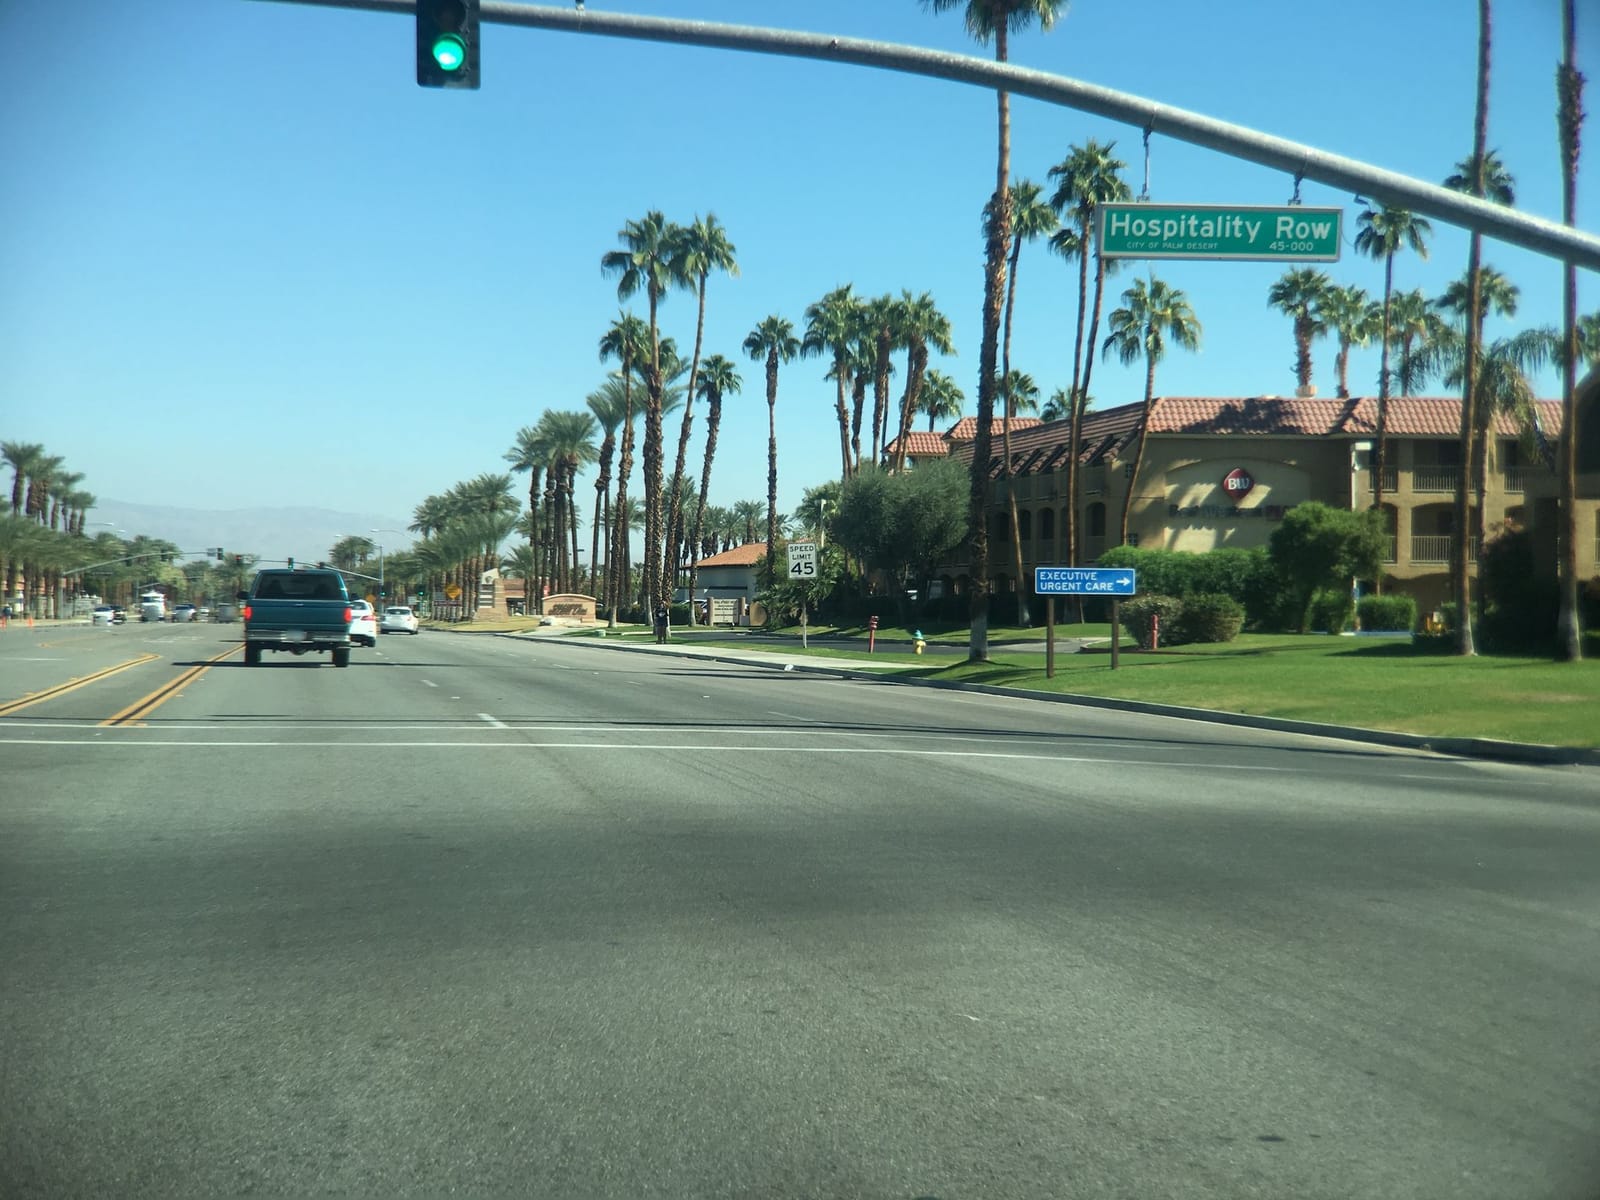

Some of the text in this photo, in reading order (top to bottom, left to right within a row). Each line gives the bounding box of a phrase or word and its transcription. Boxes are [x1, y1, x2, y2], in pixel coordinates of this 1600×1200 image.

[1111, 213, 1331, 243] Hospitality Row
[1269, 242, 1314, 251] 45-000
[1228, 478, 1249, 490] BW
[791, 562, 814, 575] 45
[1040, 571, 1097, 580] EXECUTIVE
[1040, 582, 1114, 591] URGENT CARE
